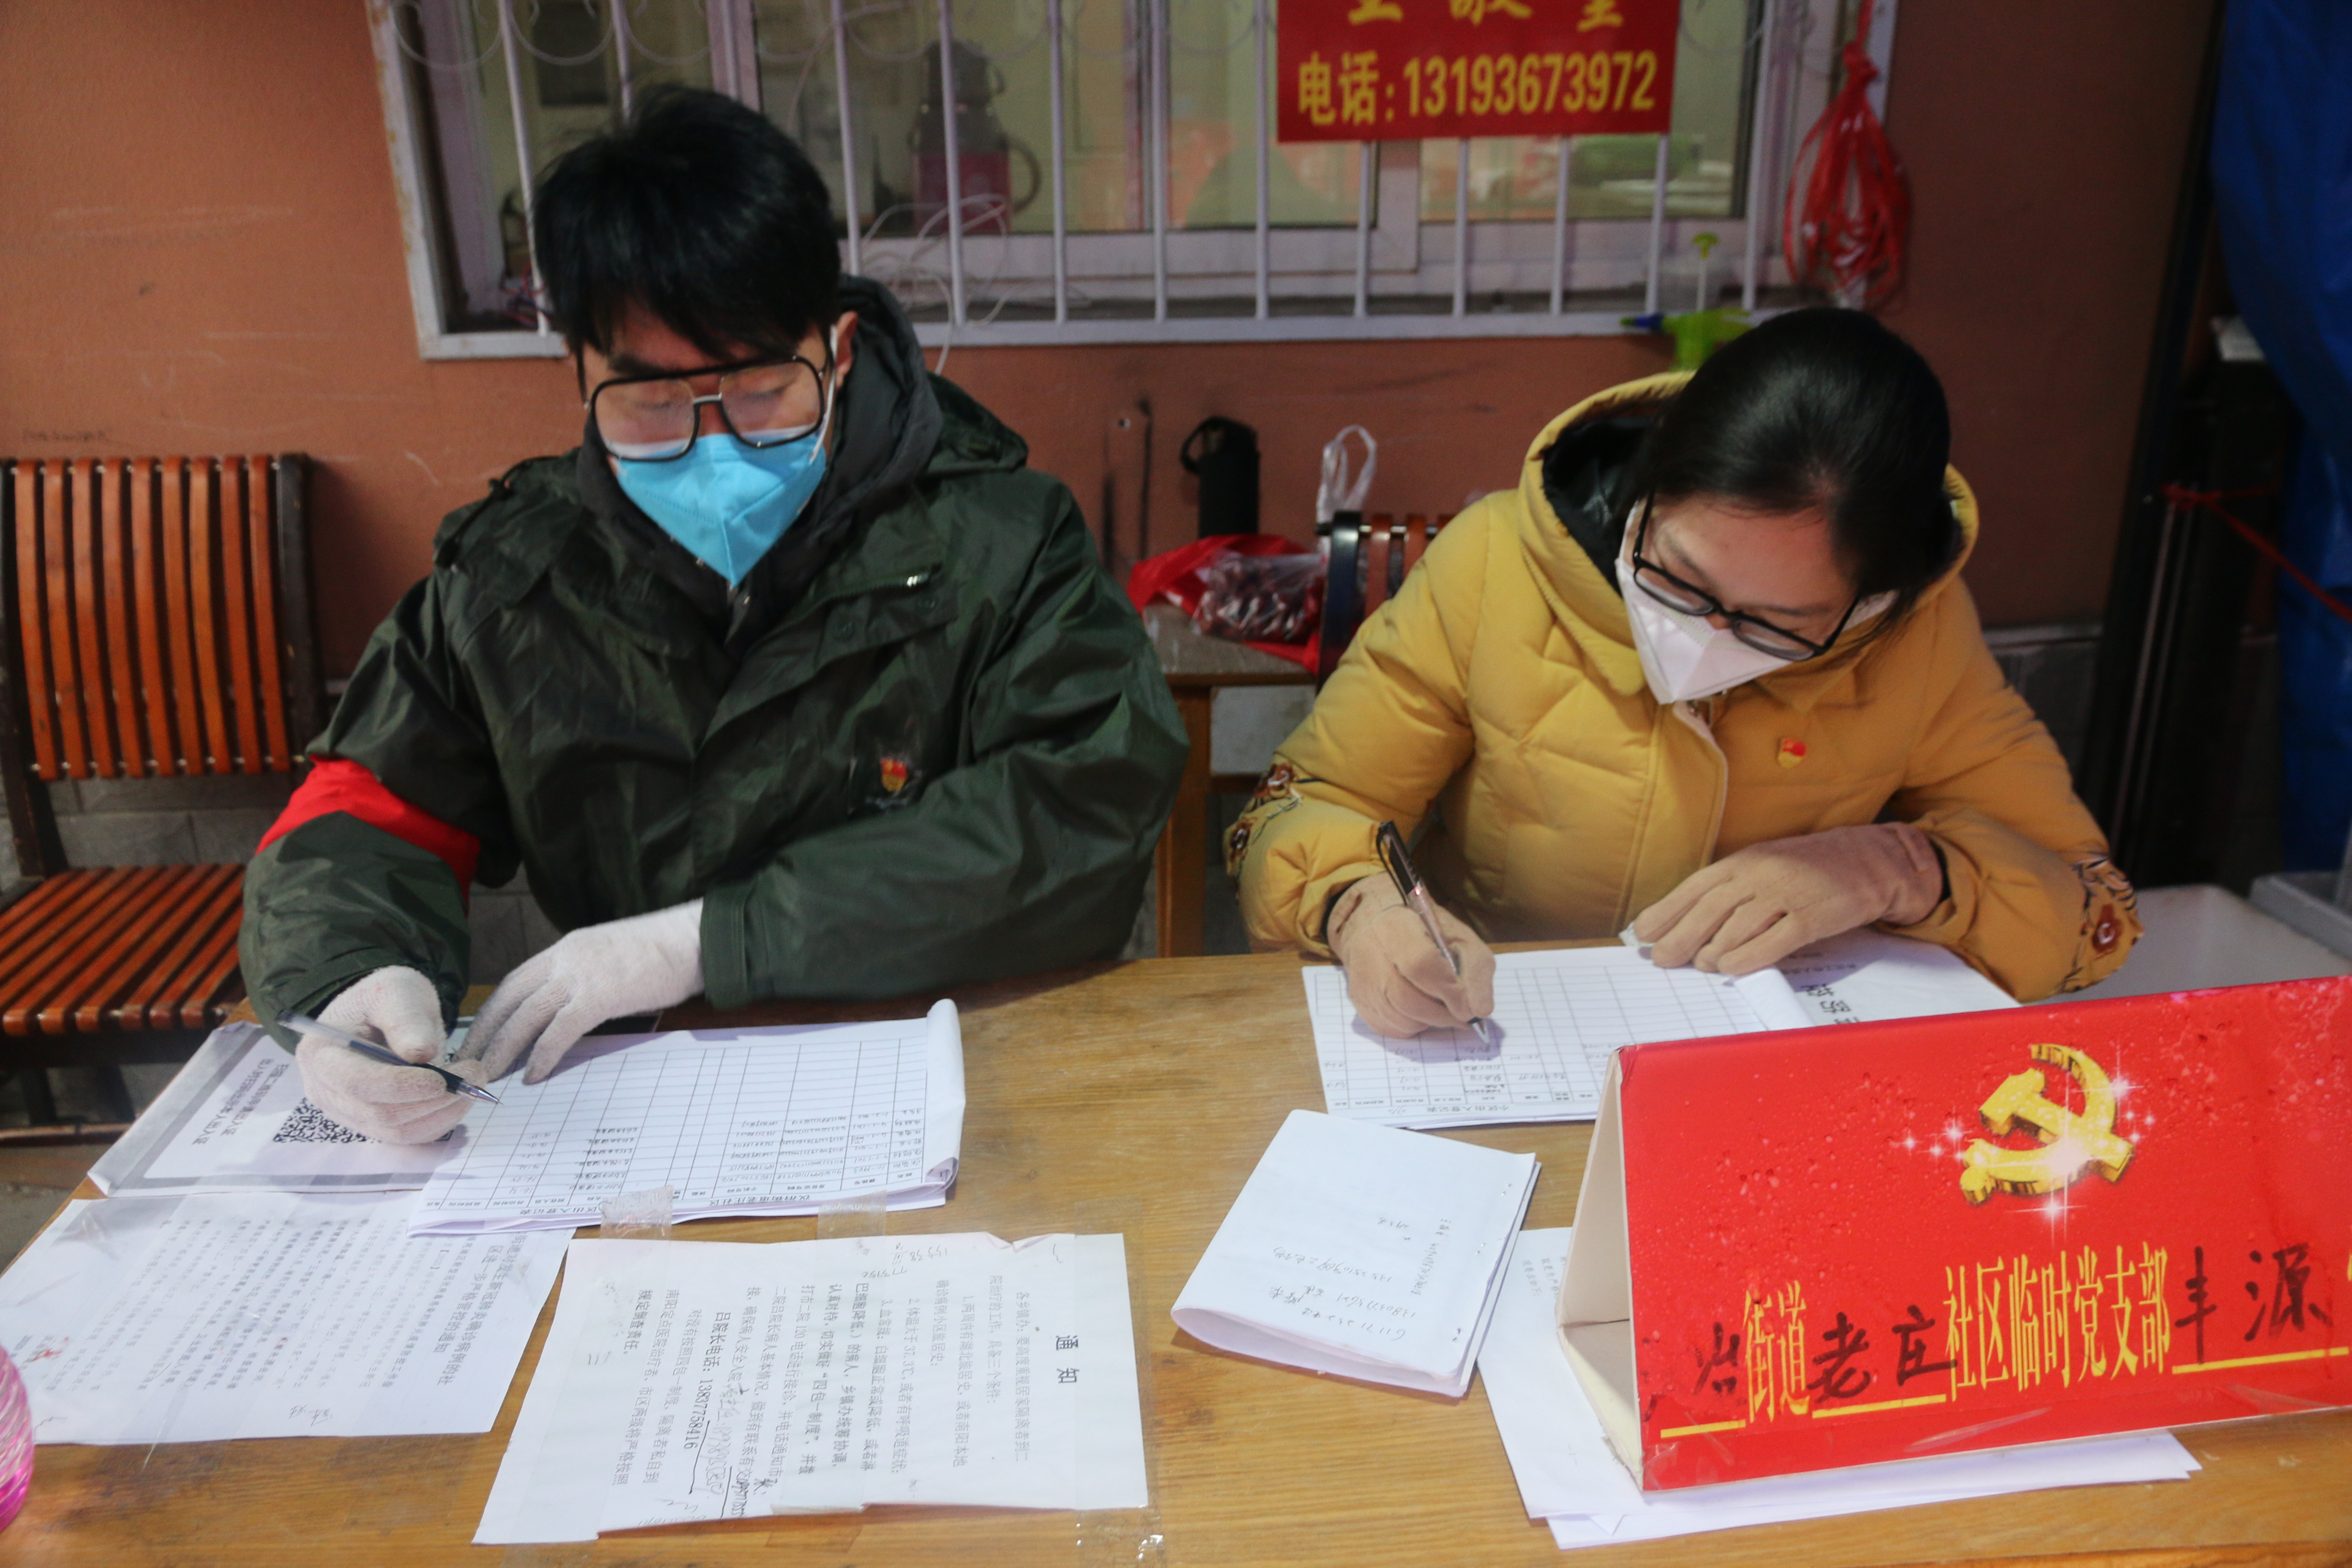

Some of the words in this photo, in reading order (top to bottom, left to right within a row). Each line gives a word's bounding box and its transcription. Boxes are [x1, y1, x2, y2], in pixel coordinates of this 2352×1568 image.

[437, 1231, 531, 1386] 街道对发生新冠肺炎确诊病例的社
[1055, 1335, 1080, 1384] 通知
[1743, 1280, 1811, 1424] 街道
[1943, 1241, 2171, 1403] 社区临时党支部
[2174, 1241, 2334, 1366] 丰源
